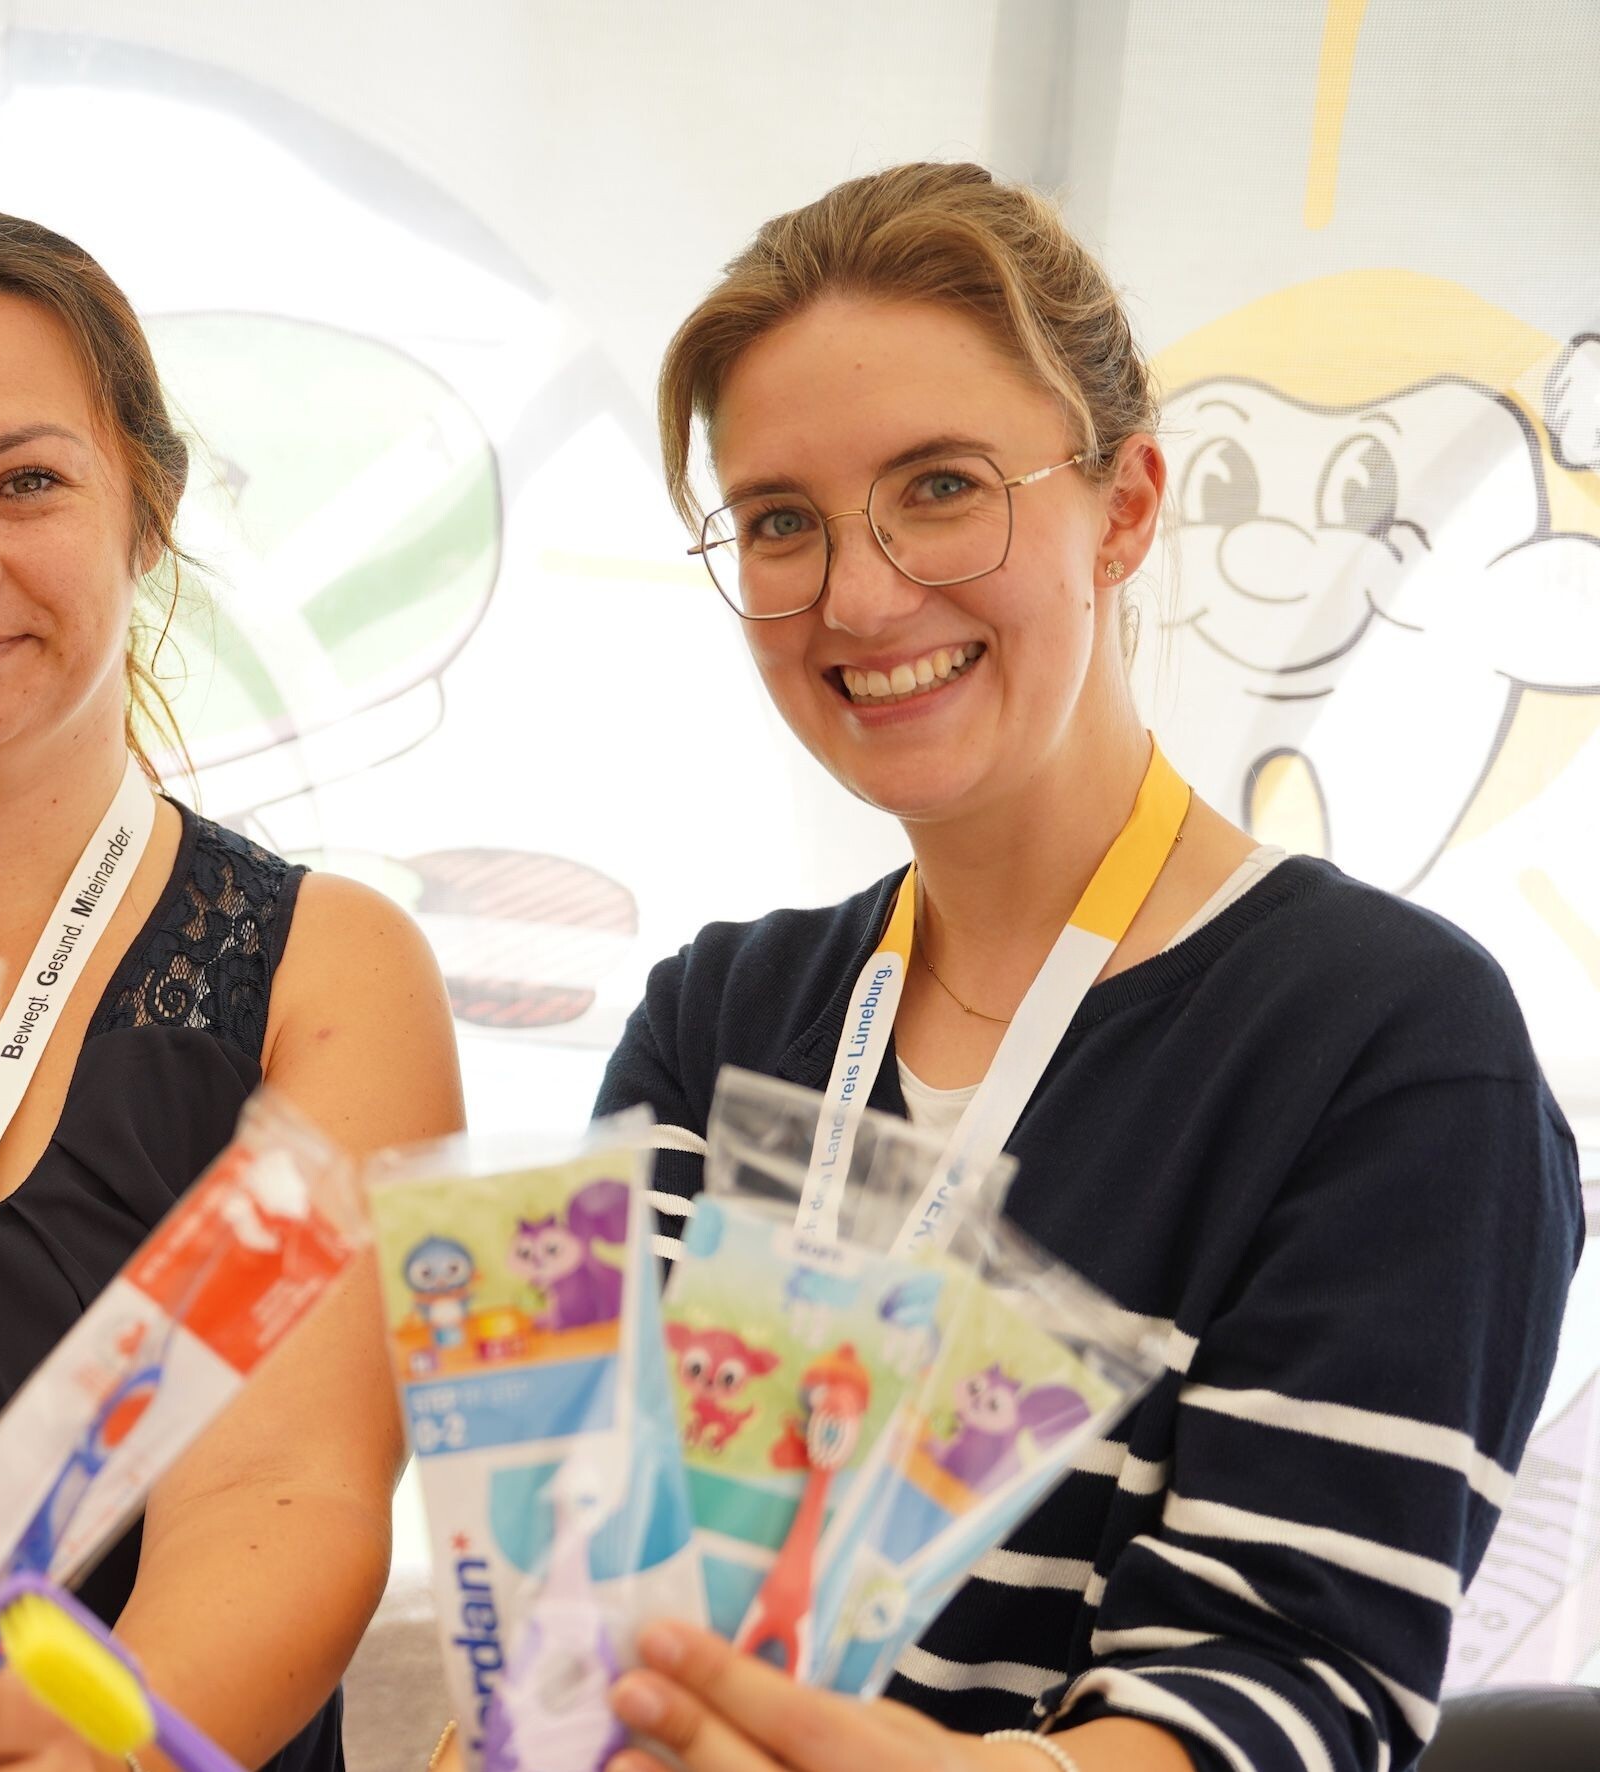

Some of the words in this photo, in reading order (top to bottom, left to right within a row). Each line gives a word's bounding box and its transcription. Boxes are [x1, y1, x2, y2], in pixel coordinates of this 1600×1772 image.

[0, 993, 49, 1060] Bewegt.
[36, 923, 85, 986] Gesund.
[70, 826, 134, 917] Miteinander.
[847, 964, 893, 1058] Lüneburg.
